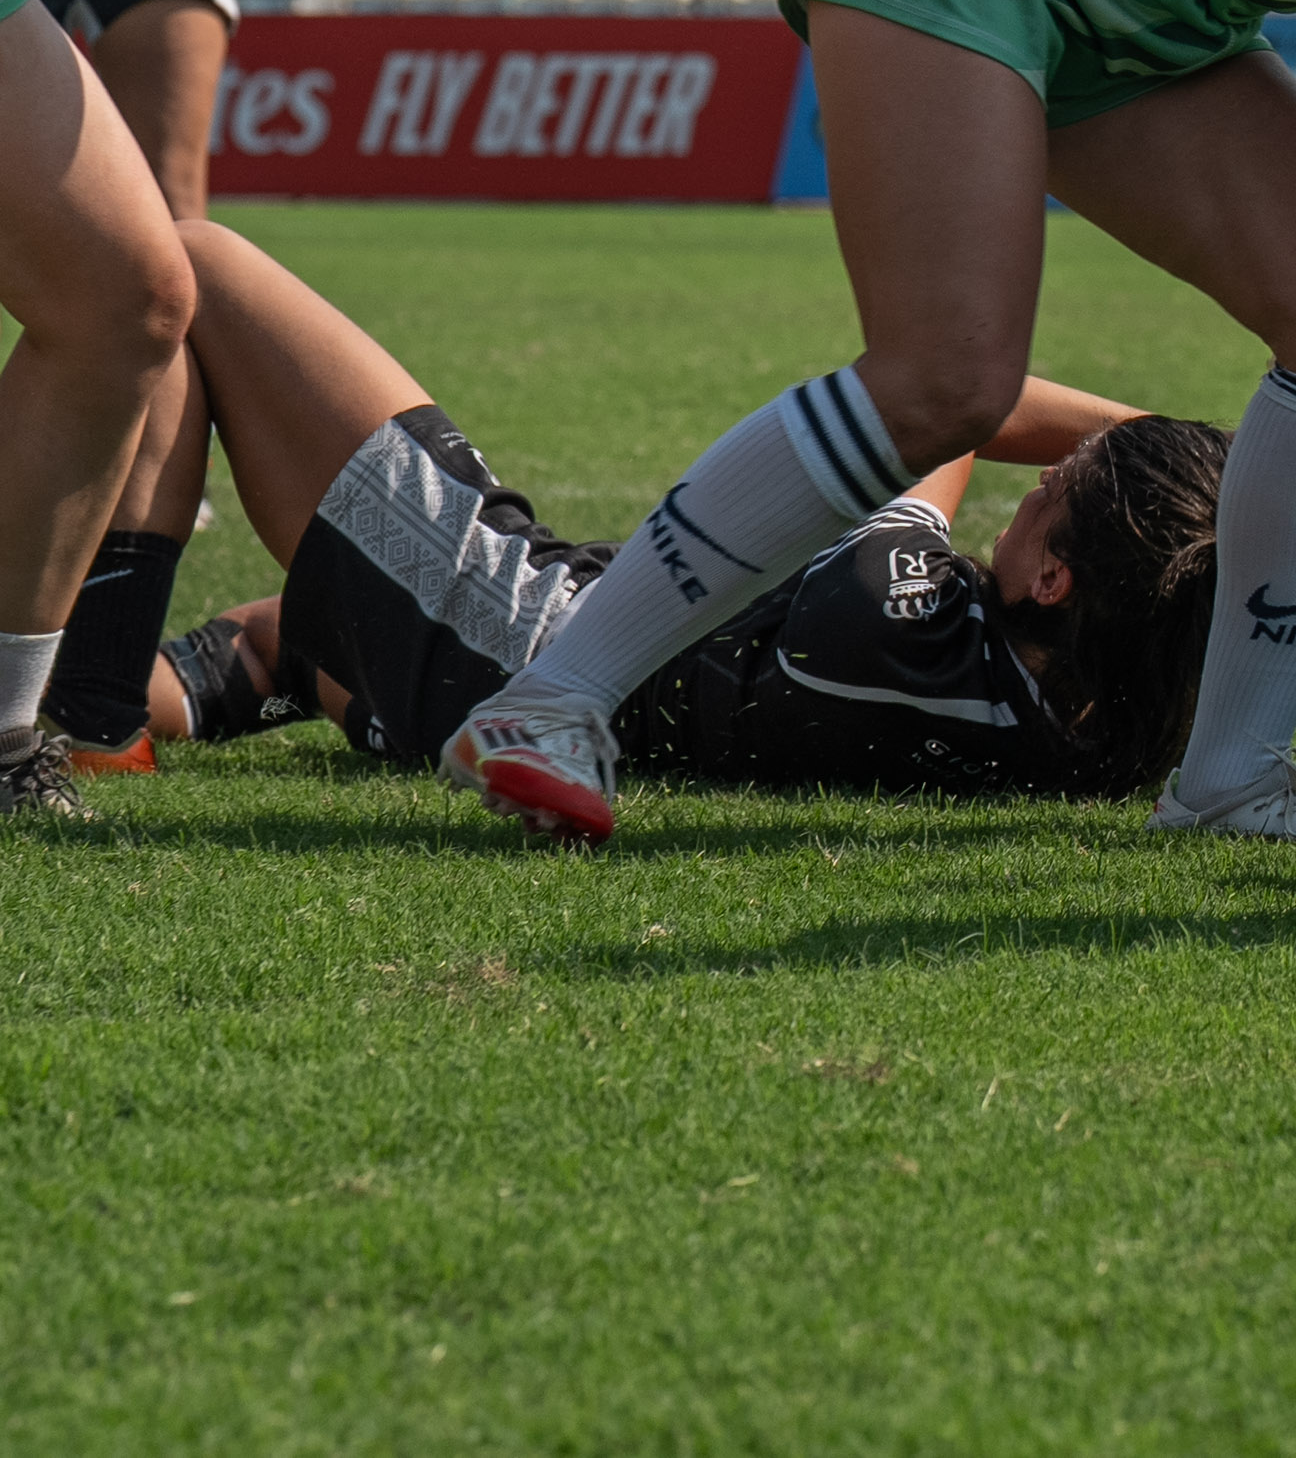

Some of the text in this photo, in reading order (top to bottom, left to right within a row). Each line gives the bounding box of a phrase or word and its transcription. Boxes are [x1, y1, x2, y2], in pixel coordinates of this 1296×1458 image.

[358, 50, 484, 155] FLY
[473, 51, 717, 157] BETTER
[646, 509, 709, 604] NIKE
